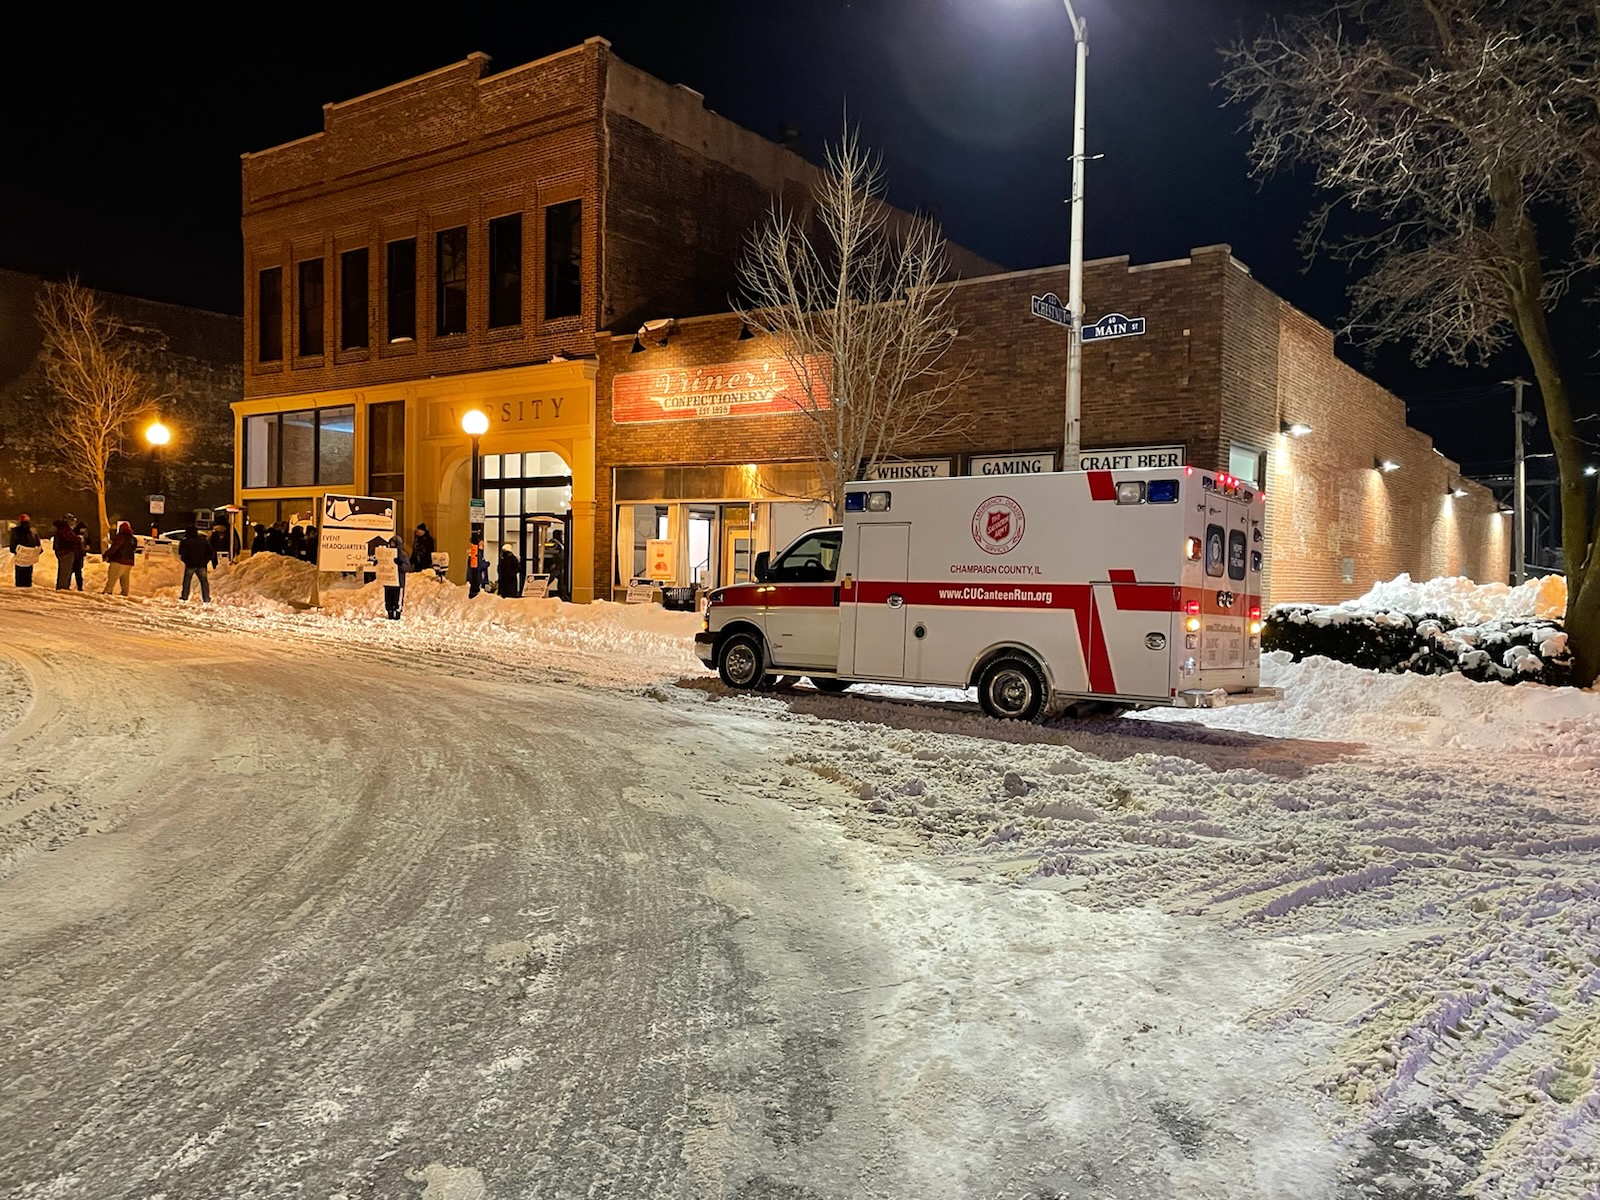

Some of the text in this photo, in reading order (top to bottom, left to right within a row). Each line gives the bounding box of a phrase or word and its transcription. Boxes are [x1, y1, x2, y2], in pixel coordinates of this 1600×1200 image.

[1094, 323, 1127, 337] MAIN
[664, 390, 769, 408] CONFECTIONERY
[449, 397, 564, 426] VRSITY
[982, 459, 1041, 475] GAMING
[1080, 453, 1179, 471] CRAFT BEER
[877, 464, 938, 479] WHISKEY
[950, 564, 1042, 576] CHAMPAIGN COUNTY, IL
[939, 587, 1053, 604] www.CUCanteenRun.org
